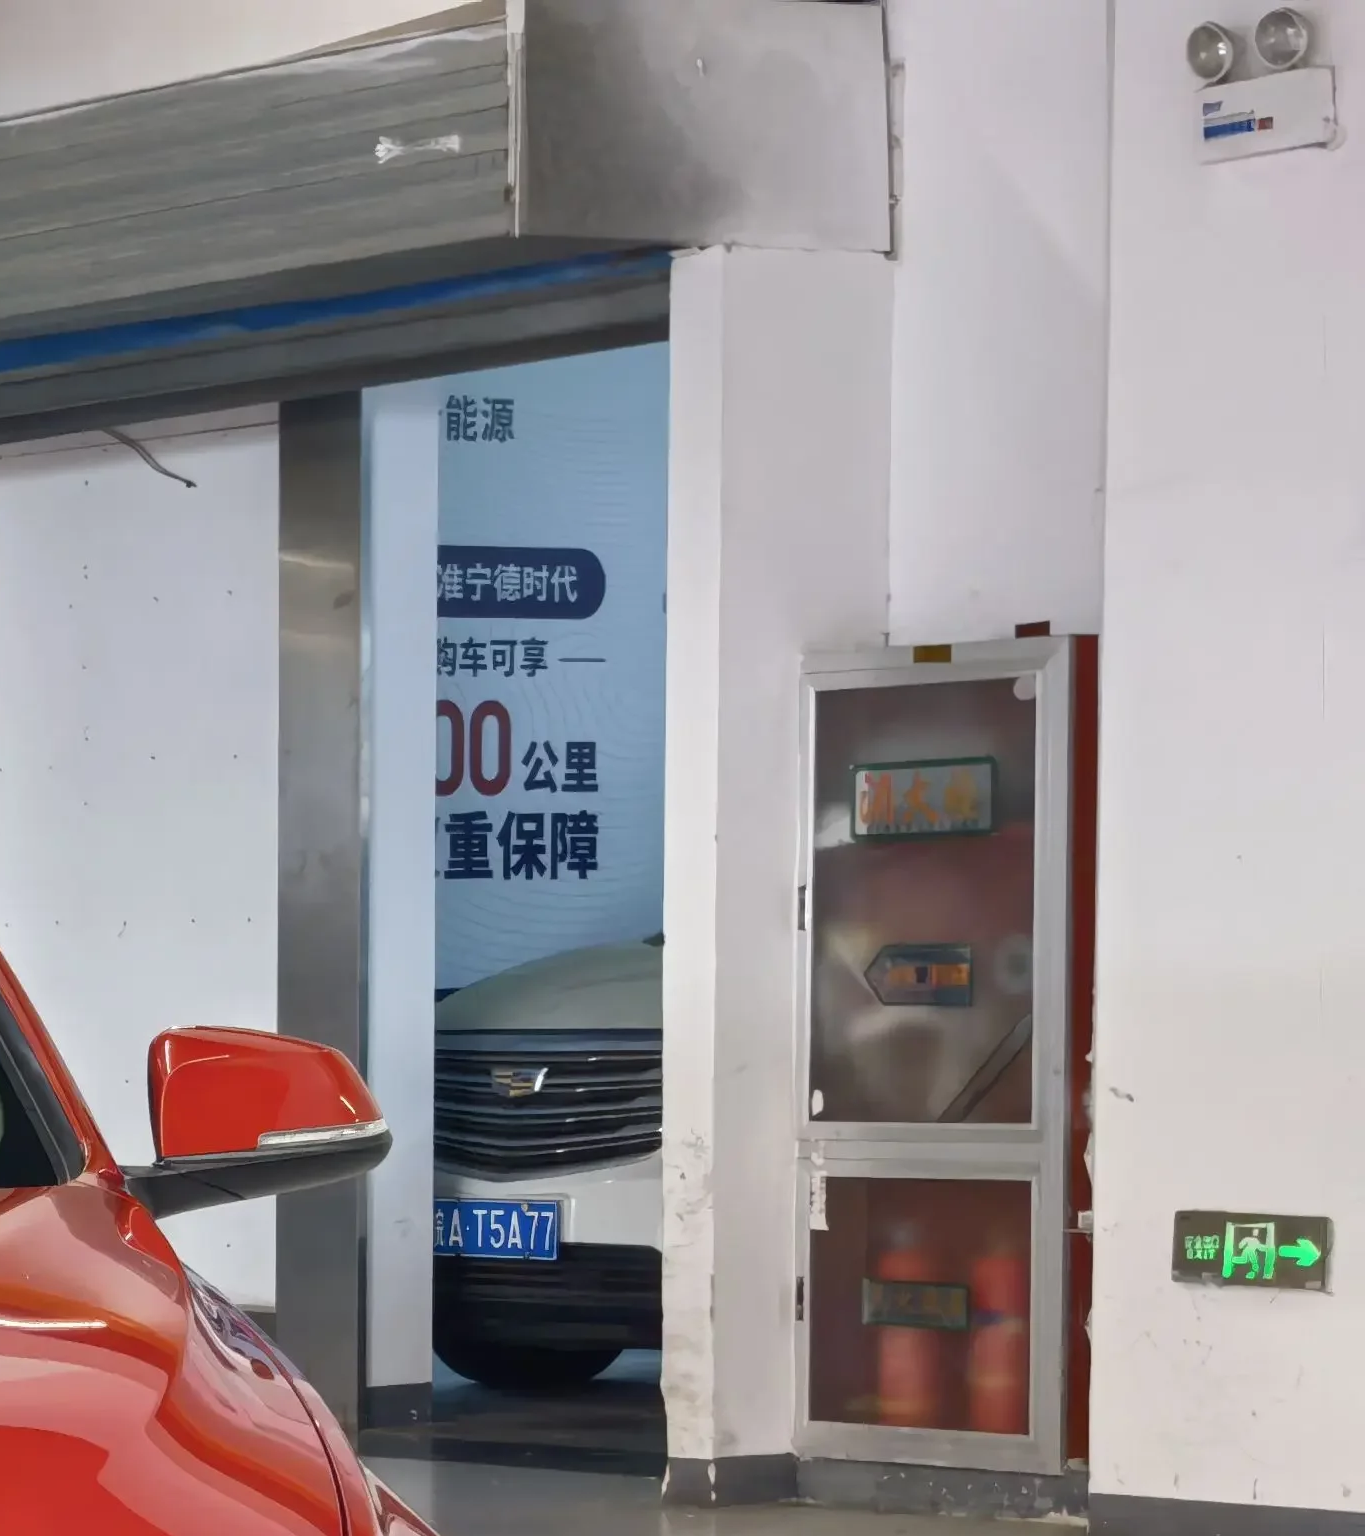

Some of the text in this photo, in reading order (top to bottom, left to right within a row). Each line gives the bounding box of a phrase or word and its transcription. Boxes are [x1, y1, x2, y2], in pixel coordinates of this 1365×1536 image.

[438, 395, 515, 441] 能源
[437, 636, 549, 678] 购车可享
[520, 740, 599, 793] 公里
[436, 810, 600, 881] 重保障
